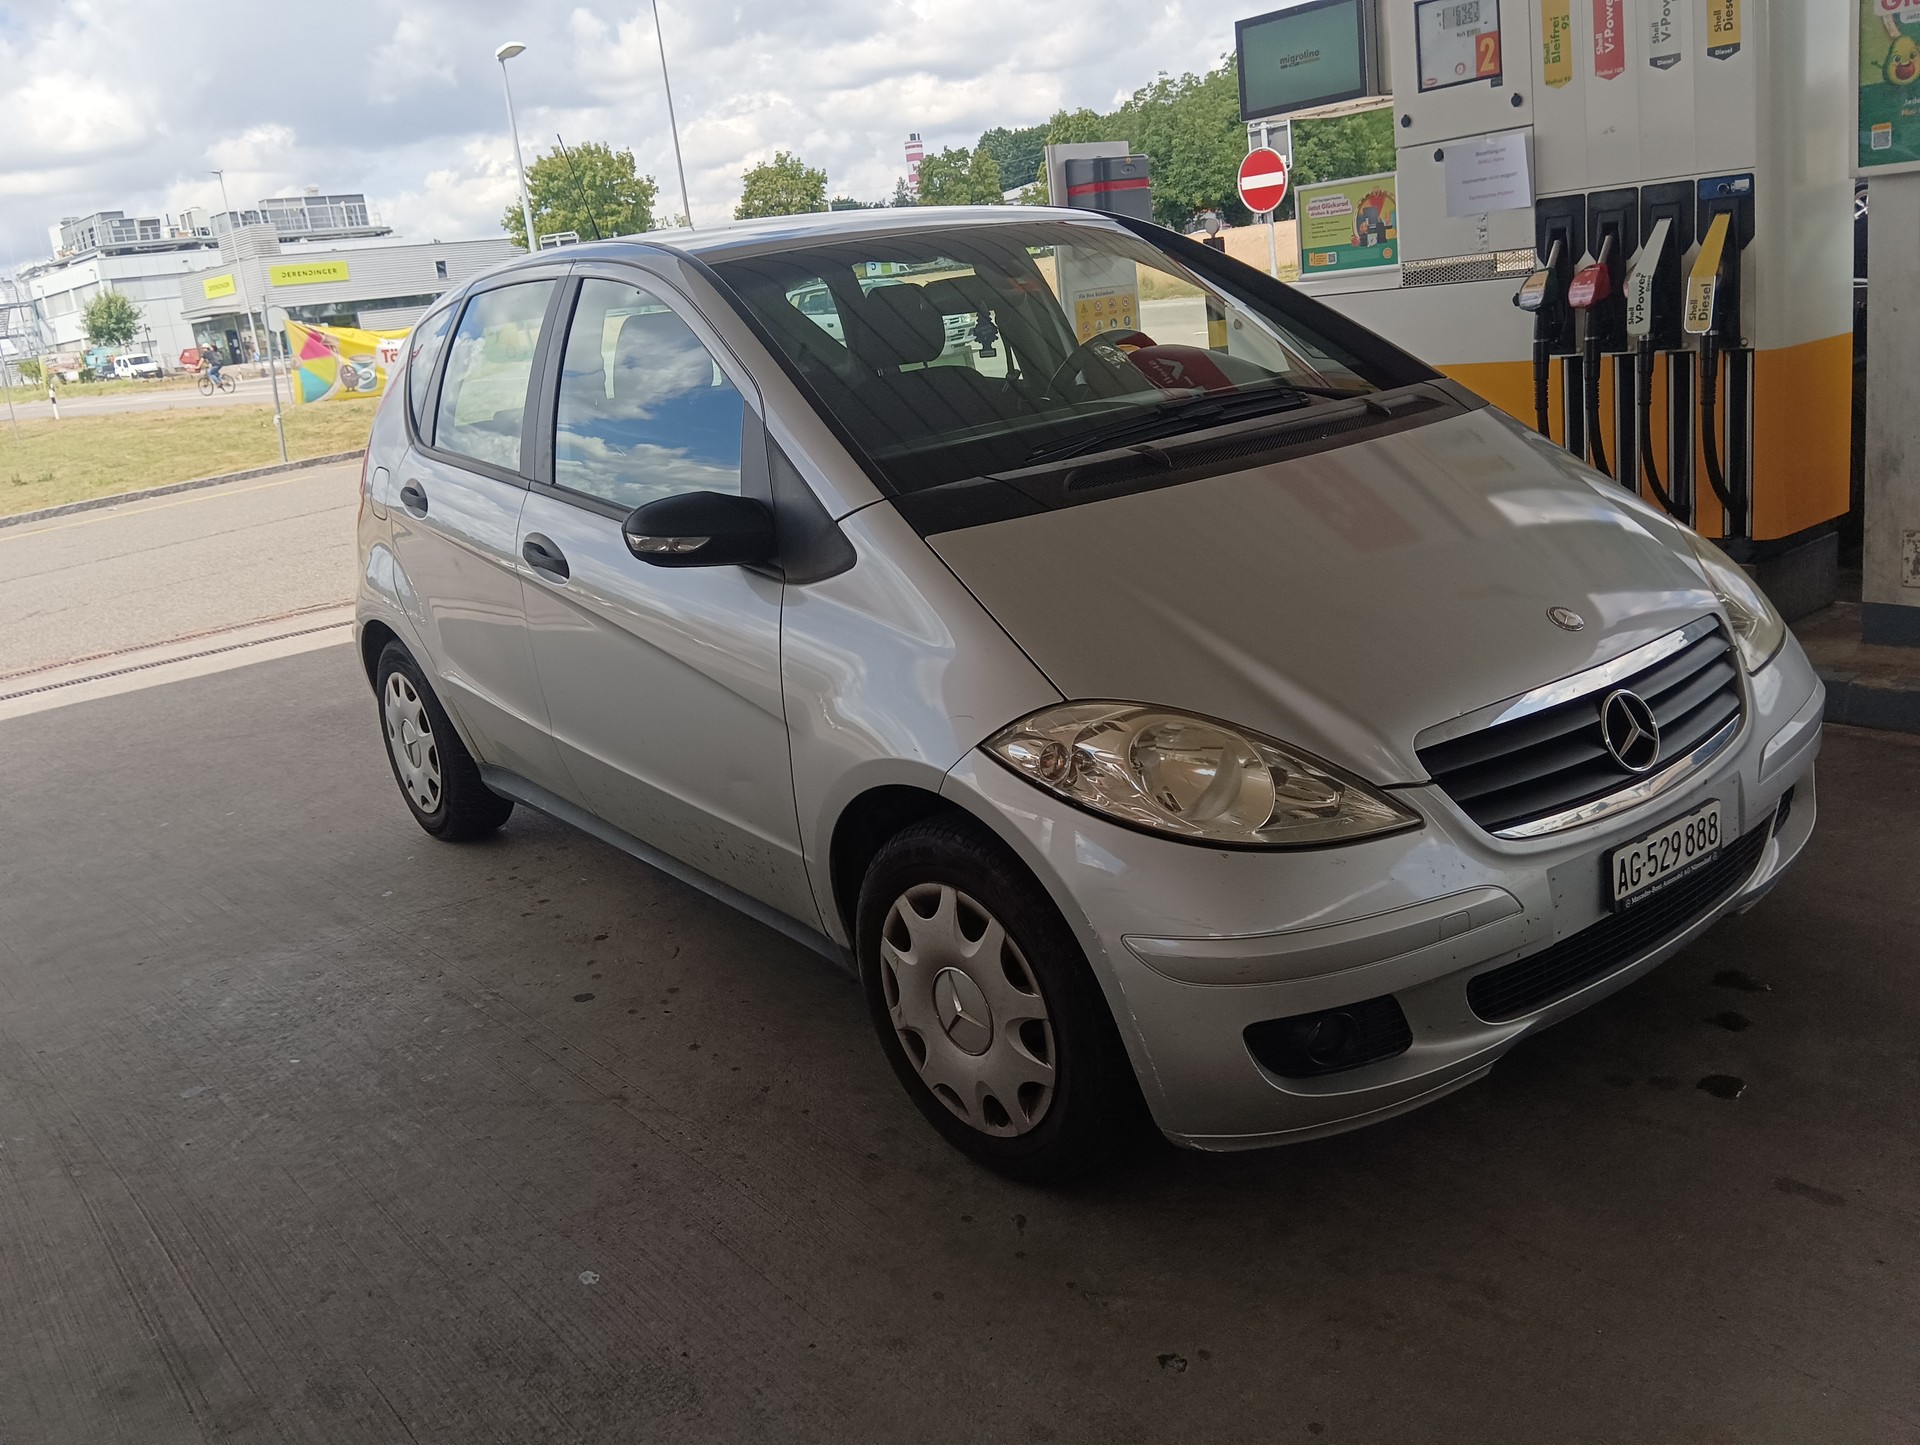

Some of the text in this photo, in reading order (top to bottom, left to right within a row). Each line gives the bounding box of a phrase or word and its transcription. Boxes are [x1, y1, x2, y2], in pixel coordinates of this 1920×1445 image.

[1561, 15, 1569, 30] 95
[1713, 9, 1721, 32] Shell
[1550, 16, 1561, 64] Bleifrei
[1595, 33, 1603, 55] Shell
[1652, 22, 1660, 44] Shell
[1280, 49, 1320, 65] migrolino
[1480, 37, 1495, 72] 2
[1543, 43, 1551, 65] Shell
[1657, 58, 1674, 66] Diesel
[1715, 47, 1732, 56] Diesel
[1307, 200, 1349, 212] Jetzt Glücksrad
[1635, 274, 1647, 324] V-Power
[1689, 299, 1698, 321] Shell
[1698, 283, 1712, 321] Diesel
